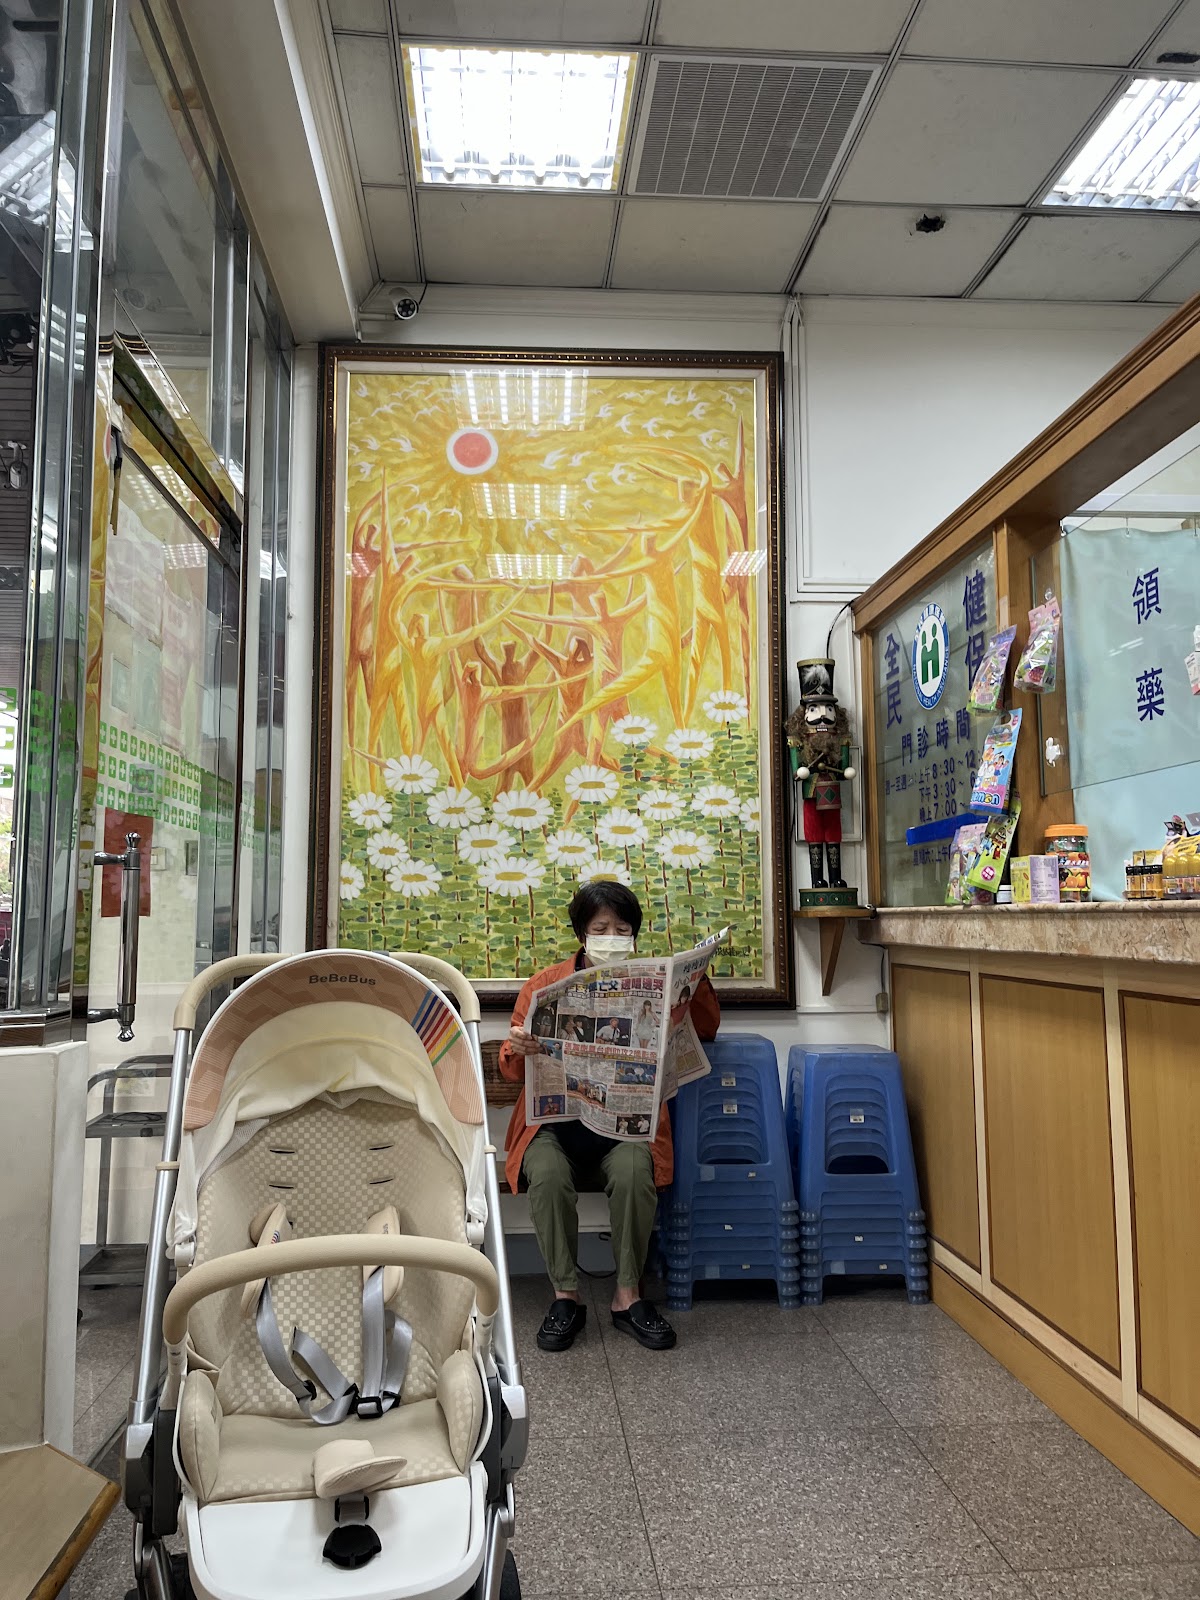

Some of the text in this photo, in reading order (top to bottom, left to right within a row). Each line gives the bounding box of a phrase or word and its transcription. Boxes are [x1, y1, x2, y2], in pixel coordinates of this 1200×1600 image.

[963, 568, 988, 692] 健保
[1132, 567, 1166, 722] 領藥
[884, 633, 903, 731] 全民
[901, 707, 971, 767] 門診時間
[309, 973, 376, 986] BeBeBus
